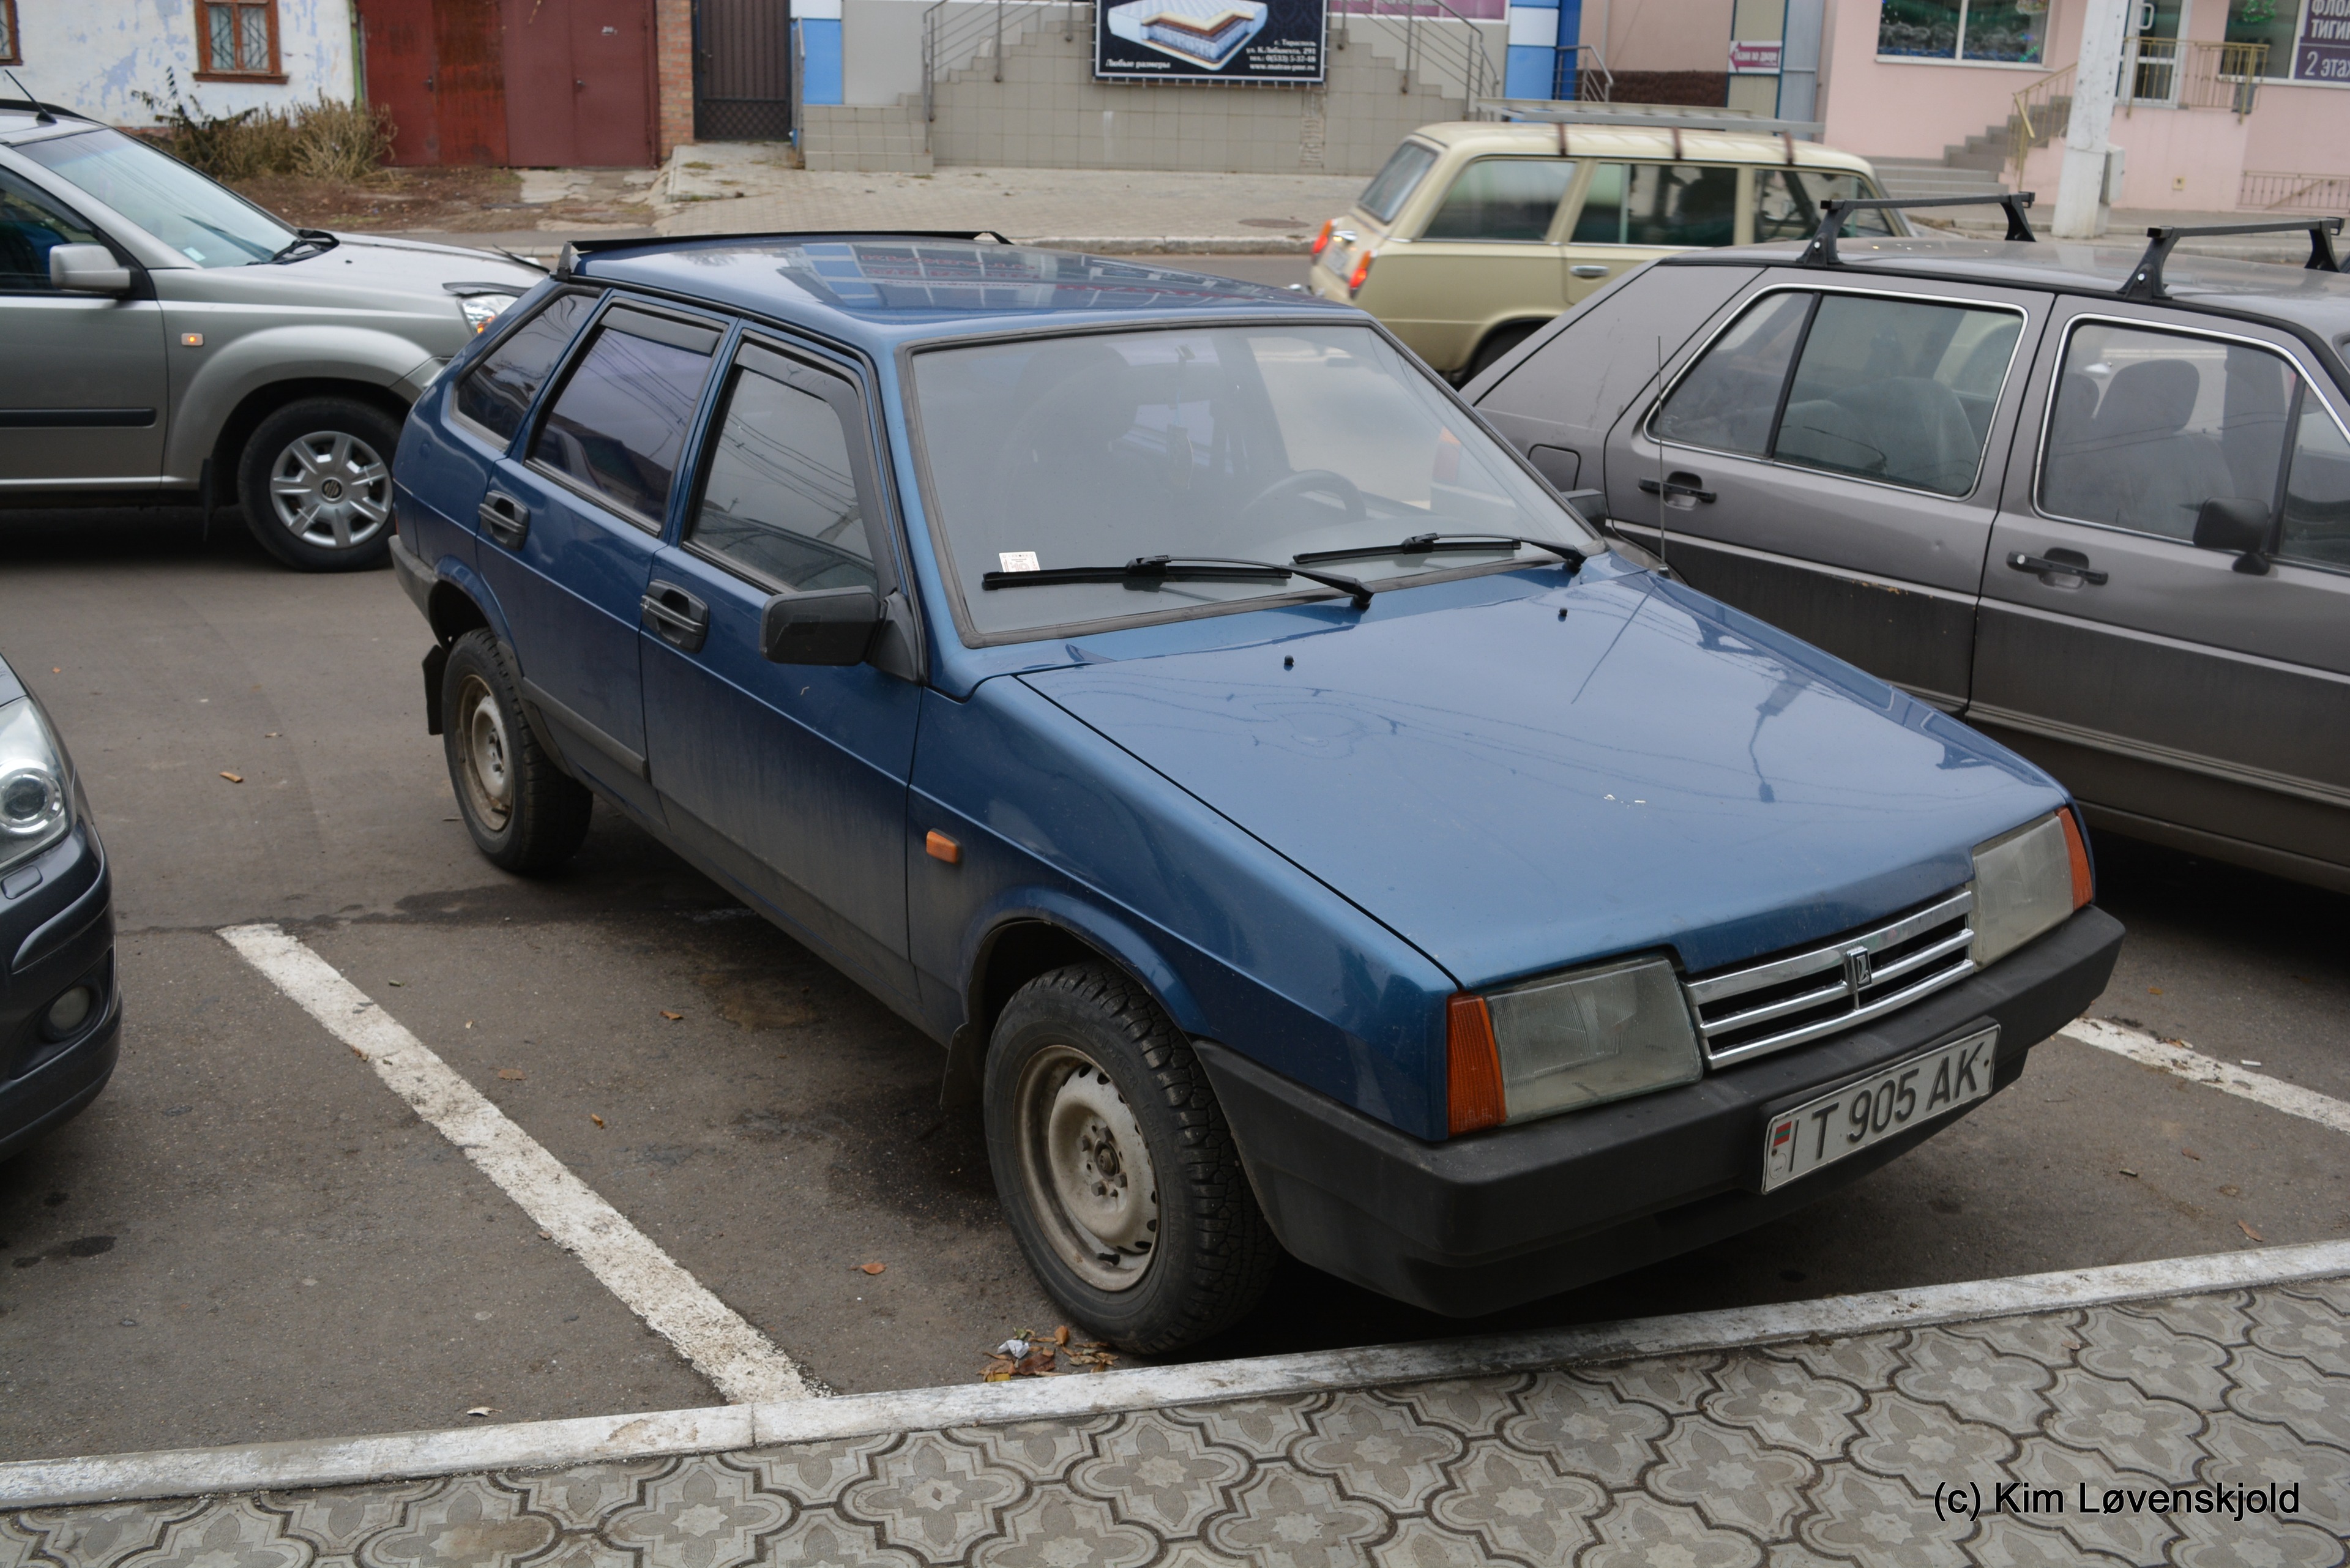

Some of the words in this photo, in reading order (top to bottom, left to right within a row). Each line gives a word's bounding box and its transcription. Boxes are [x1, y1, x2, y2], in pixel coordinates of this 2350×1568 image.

[1105, 58, 1135, 67] Любые
[1135, 61, 1171, 70] размеры
[2304, 51, 2318, 77] 2
[1812, 1102, 1840, 1160] T
[1847, 1067, 1920, 1143] 905
[1926, 1041, 1985, 1111] AK
